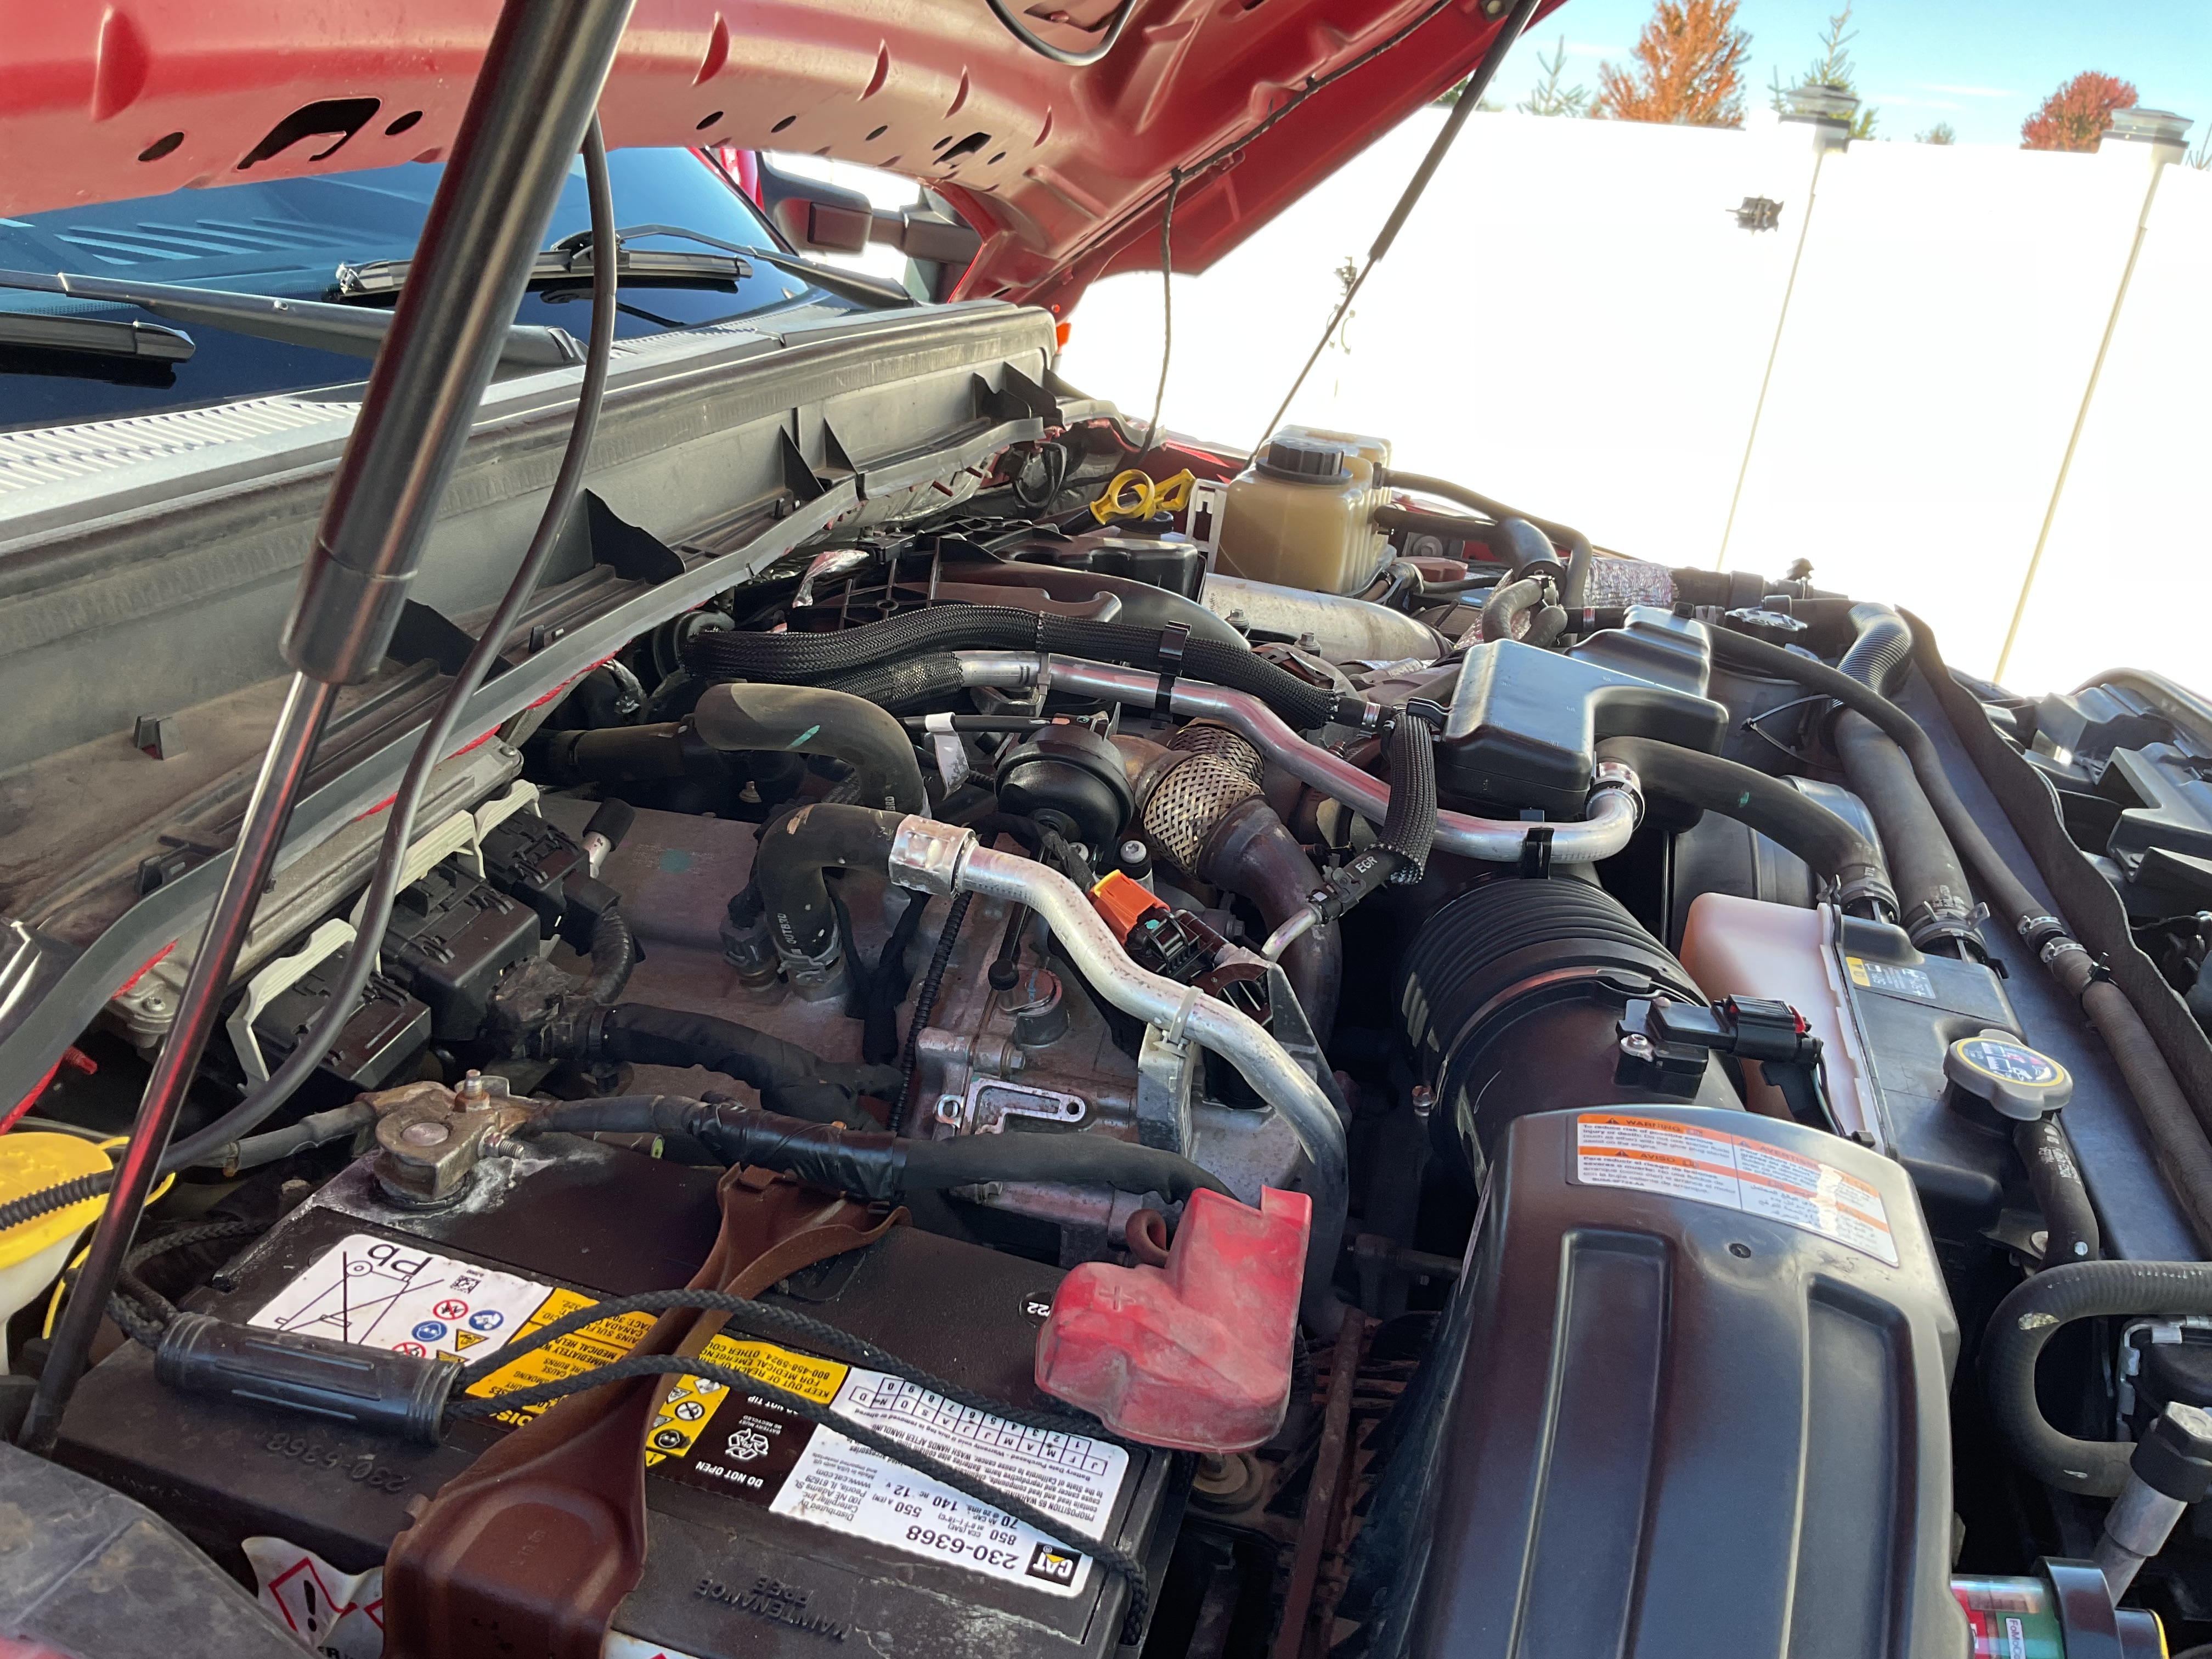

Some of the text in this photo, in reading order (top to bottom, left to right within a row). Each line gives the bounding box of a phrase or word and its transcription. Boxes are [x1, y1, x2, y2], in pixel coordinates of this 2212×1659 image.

[1355, 856, 1378, 873] EGR
[1626, 1119, 1680, 1132] WARNING
[1640, 1153, 1675, 1163] AVISO
[366, 1244, 433, 1277] Pb
[1028, 1302, 1051, 1317] 22
[602, 1321, 645, 1336] CANADA
[576, 1342, 618, 1359] MEDICAL
[699, 1347, 754, 1366] EMERGENC
[727, 1345, 760, 1360] OTHER
[540, 1365, 568, 1377] CAUSE
[754, 1359, 800, 1380] MEDICAL
[765, 1374, 781, 1384] OF
[781, 1379, 803, 1391] OUT
[798, 1375, 821, 1386] FOR
[803, 1385, 830, 1397] KEEP
[886, 1382, 895, 1390] 0
[907, 1385, 915, 1393] 9
[746, 1394, 764, 1405] TIP
[858, 1392, 868, 1401] D
[878, 1397, 888, 1406] N
[927, 1394, 935, 1403] 8
[854, 1406, 879, 1419] altered
[921, 1408, 929, 1417] S
[947, 1403, 955, 1412] 7
[887, 1413, 917, 1428] removed
[940, 1417, 950, 1425] A
[989, 1416, 997, 1425] 5
[924, 1425, 938, 1434] tag
[1010, 1423, 1018, 1431] 4
[1031, 1428, 1039, 1437] 3
[904, 1433, 927, 1446] AFTER
[936, 1430, 951, 1440] this
[983, 1431, 991, 1440] J
[1052, 1434, 1060, 1443] 2
[927, 1440, 951, 1453] HANDS
[957, 1438, 973, 1447] void
[1003, 1437, 1014, 1446] M
[1025, 1442, 1034, 1451] A
[848, 1443, 887, 1462] accessories
[950, 1447, 972, 1460] WASH
[973, 1441, 1005, 1457] Warranty
[1046, 1448, 1057, 1458] M
[811, 1451, 839, 1463] materials
[936, 1452, 952, 1462] also
[972, 1454, 997, 1467] cancer.
[1009, 1452, 1047, 1469] Purchased
[1068, 1455, 1076, 1463] F
[838, 1459, 866, 1471] imported
[951, 1457, 981, 1472] Batteries
[996, 1462, 1017, 1473] cause
[1047, 1464, 1064, 1474] Date
[1090, 1461, 1098, 1470] J
[695, 1460, 764, 1487] DO NOT OPEN
[983, 1466, 1002, 1477] harm.
[1016, 1468, 1024, 1476] to
[1025, 1469, 1057, 1485] California
[1065, 1468, 1091, 1482] Battery
[814, 1468, 872, 1489] www.cat.com
[986, 1474, 1028, 1493] compounds,
[1002, 1470, 1043, 1489] reproductive
[1057, 1479, 1065, 1487] of
[804, 1474, 867, 1497] Peoria, IL 61629
[804, 1482, 834, 1497] Adams
[892, 1483, 912, 1498] 12
[1043, 1483, 1057, 1493] and
[1065, 1481, 1083, 1492] State
[1084, 1487, 1095, 1496] the
[833, 1491, 848, 1500] NE
[871, 1493, 888, 1503] (EN)
[1027, 1487, 1042, 1498] lead
[1042, 1492, 1056, 1501] and
[1057, 1487, 1080, 1499] cancer
[799, 1489, 860, 1513] Caterpillar Inc.
[847, 1495, 862, 1505] 100
[918, 1490, 960, 1512] 140 RC
[1037, 1499, 1048, 1508] 65
[1056, 1496, 1072, 1506] lead
[1080, 1494, 1101, 1506] cause
[797, 1498, 855, 1521] Distributed by
[893, 1500, 923, 1517] 550
[1047, 1502, 1095, 1522] PROPOSITION
[1072, 1500, 1098, 1513] contain
[999, 1514, 1020, 1530] 70
[946, 1522, 981, 1537] CCA (SAE)
[988, 1528, 1017, 1545] 850
[902, 1524, 1020, 1571] 230-6368
[1031, 1549, 1075, 1578] CAT
[754, 1578, 813, 1605] FREE
[696, 1580, 851, 1640] MAINTENANCE
